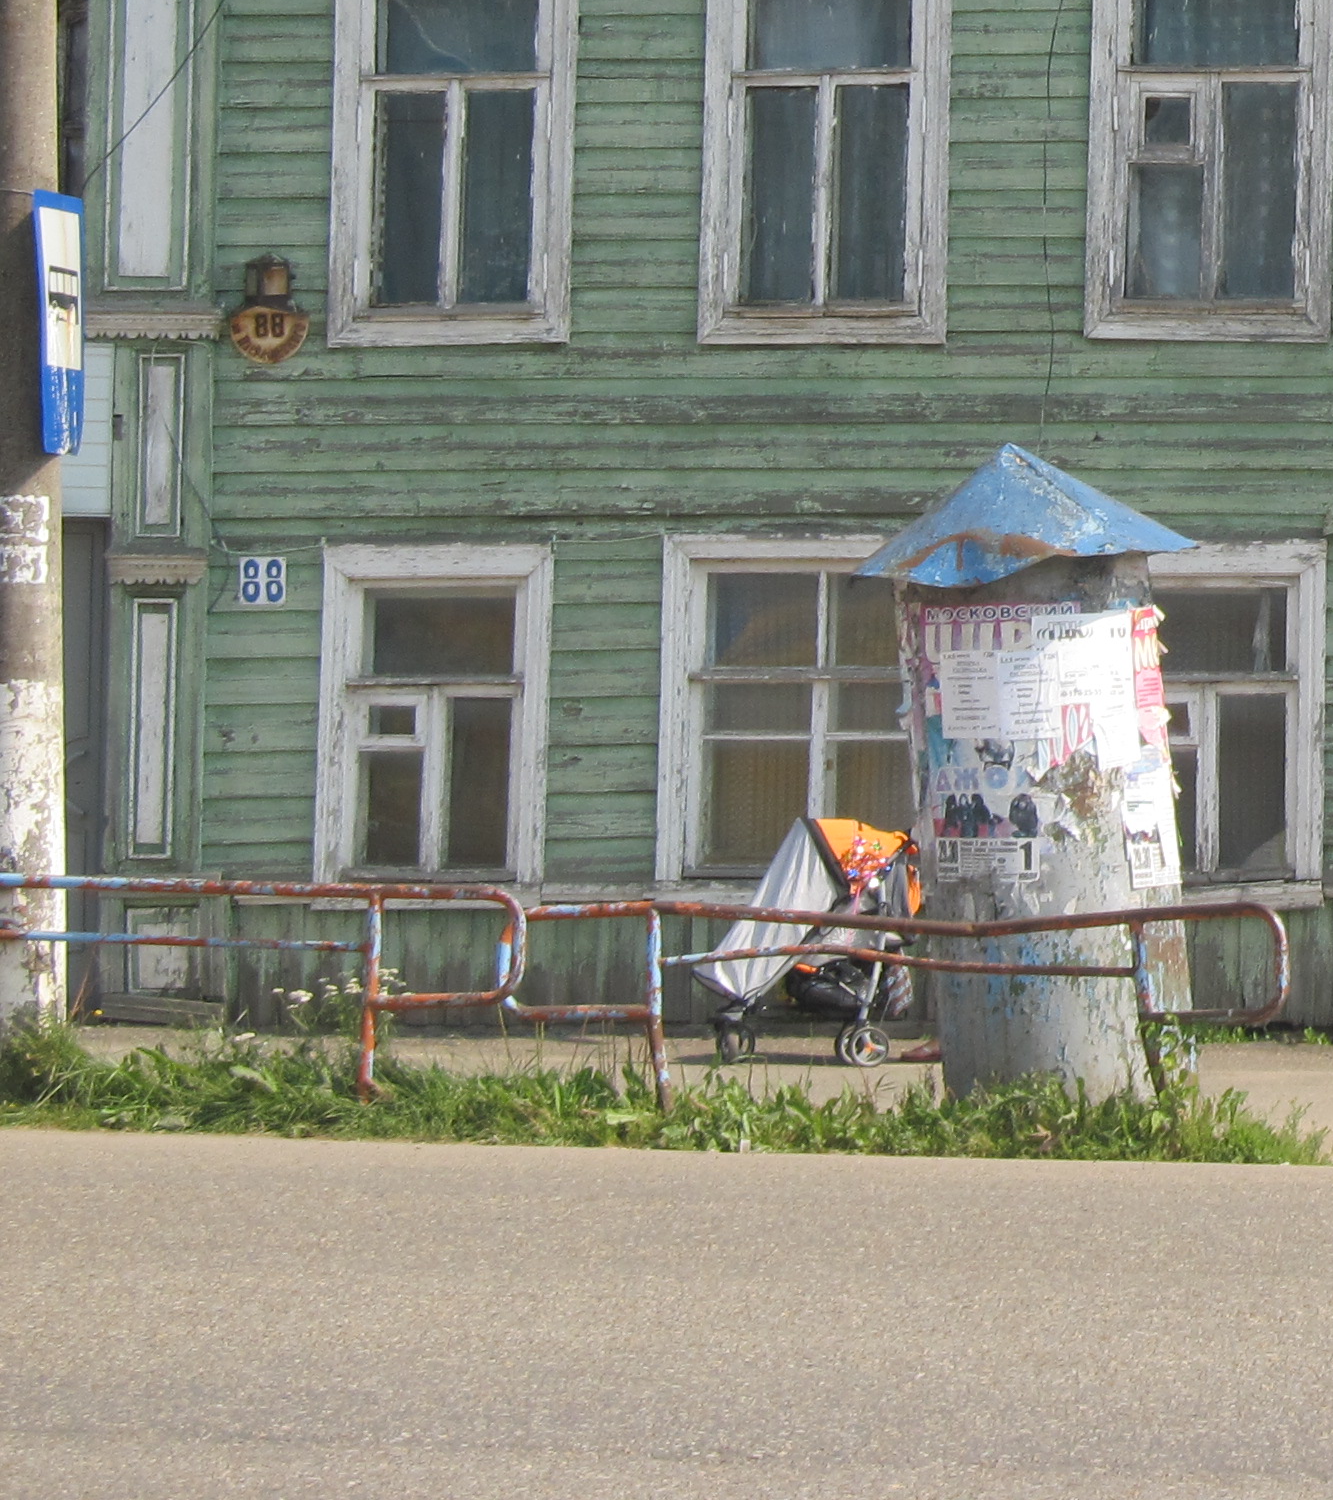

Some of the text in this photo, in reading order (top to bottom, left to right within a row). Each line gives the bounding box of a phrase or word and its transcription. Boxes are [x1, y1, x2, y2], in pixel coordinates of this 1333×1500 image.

[254, 312, 285, 338] 88
[242, 559, 284, 603] 88
[926, 603, 1074, 621] МОСКОВСКИЙ
